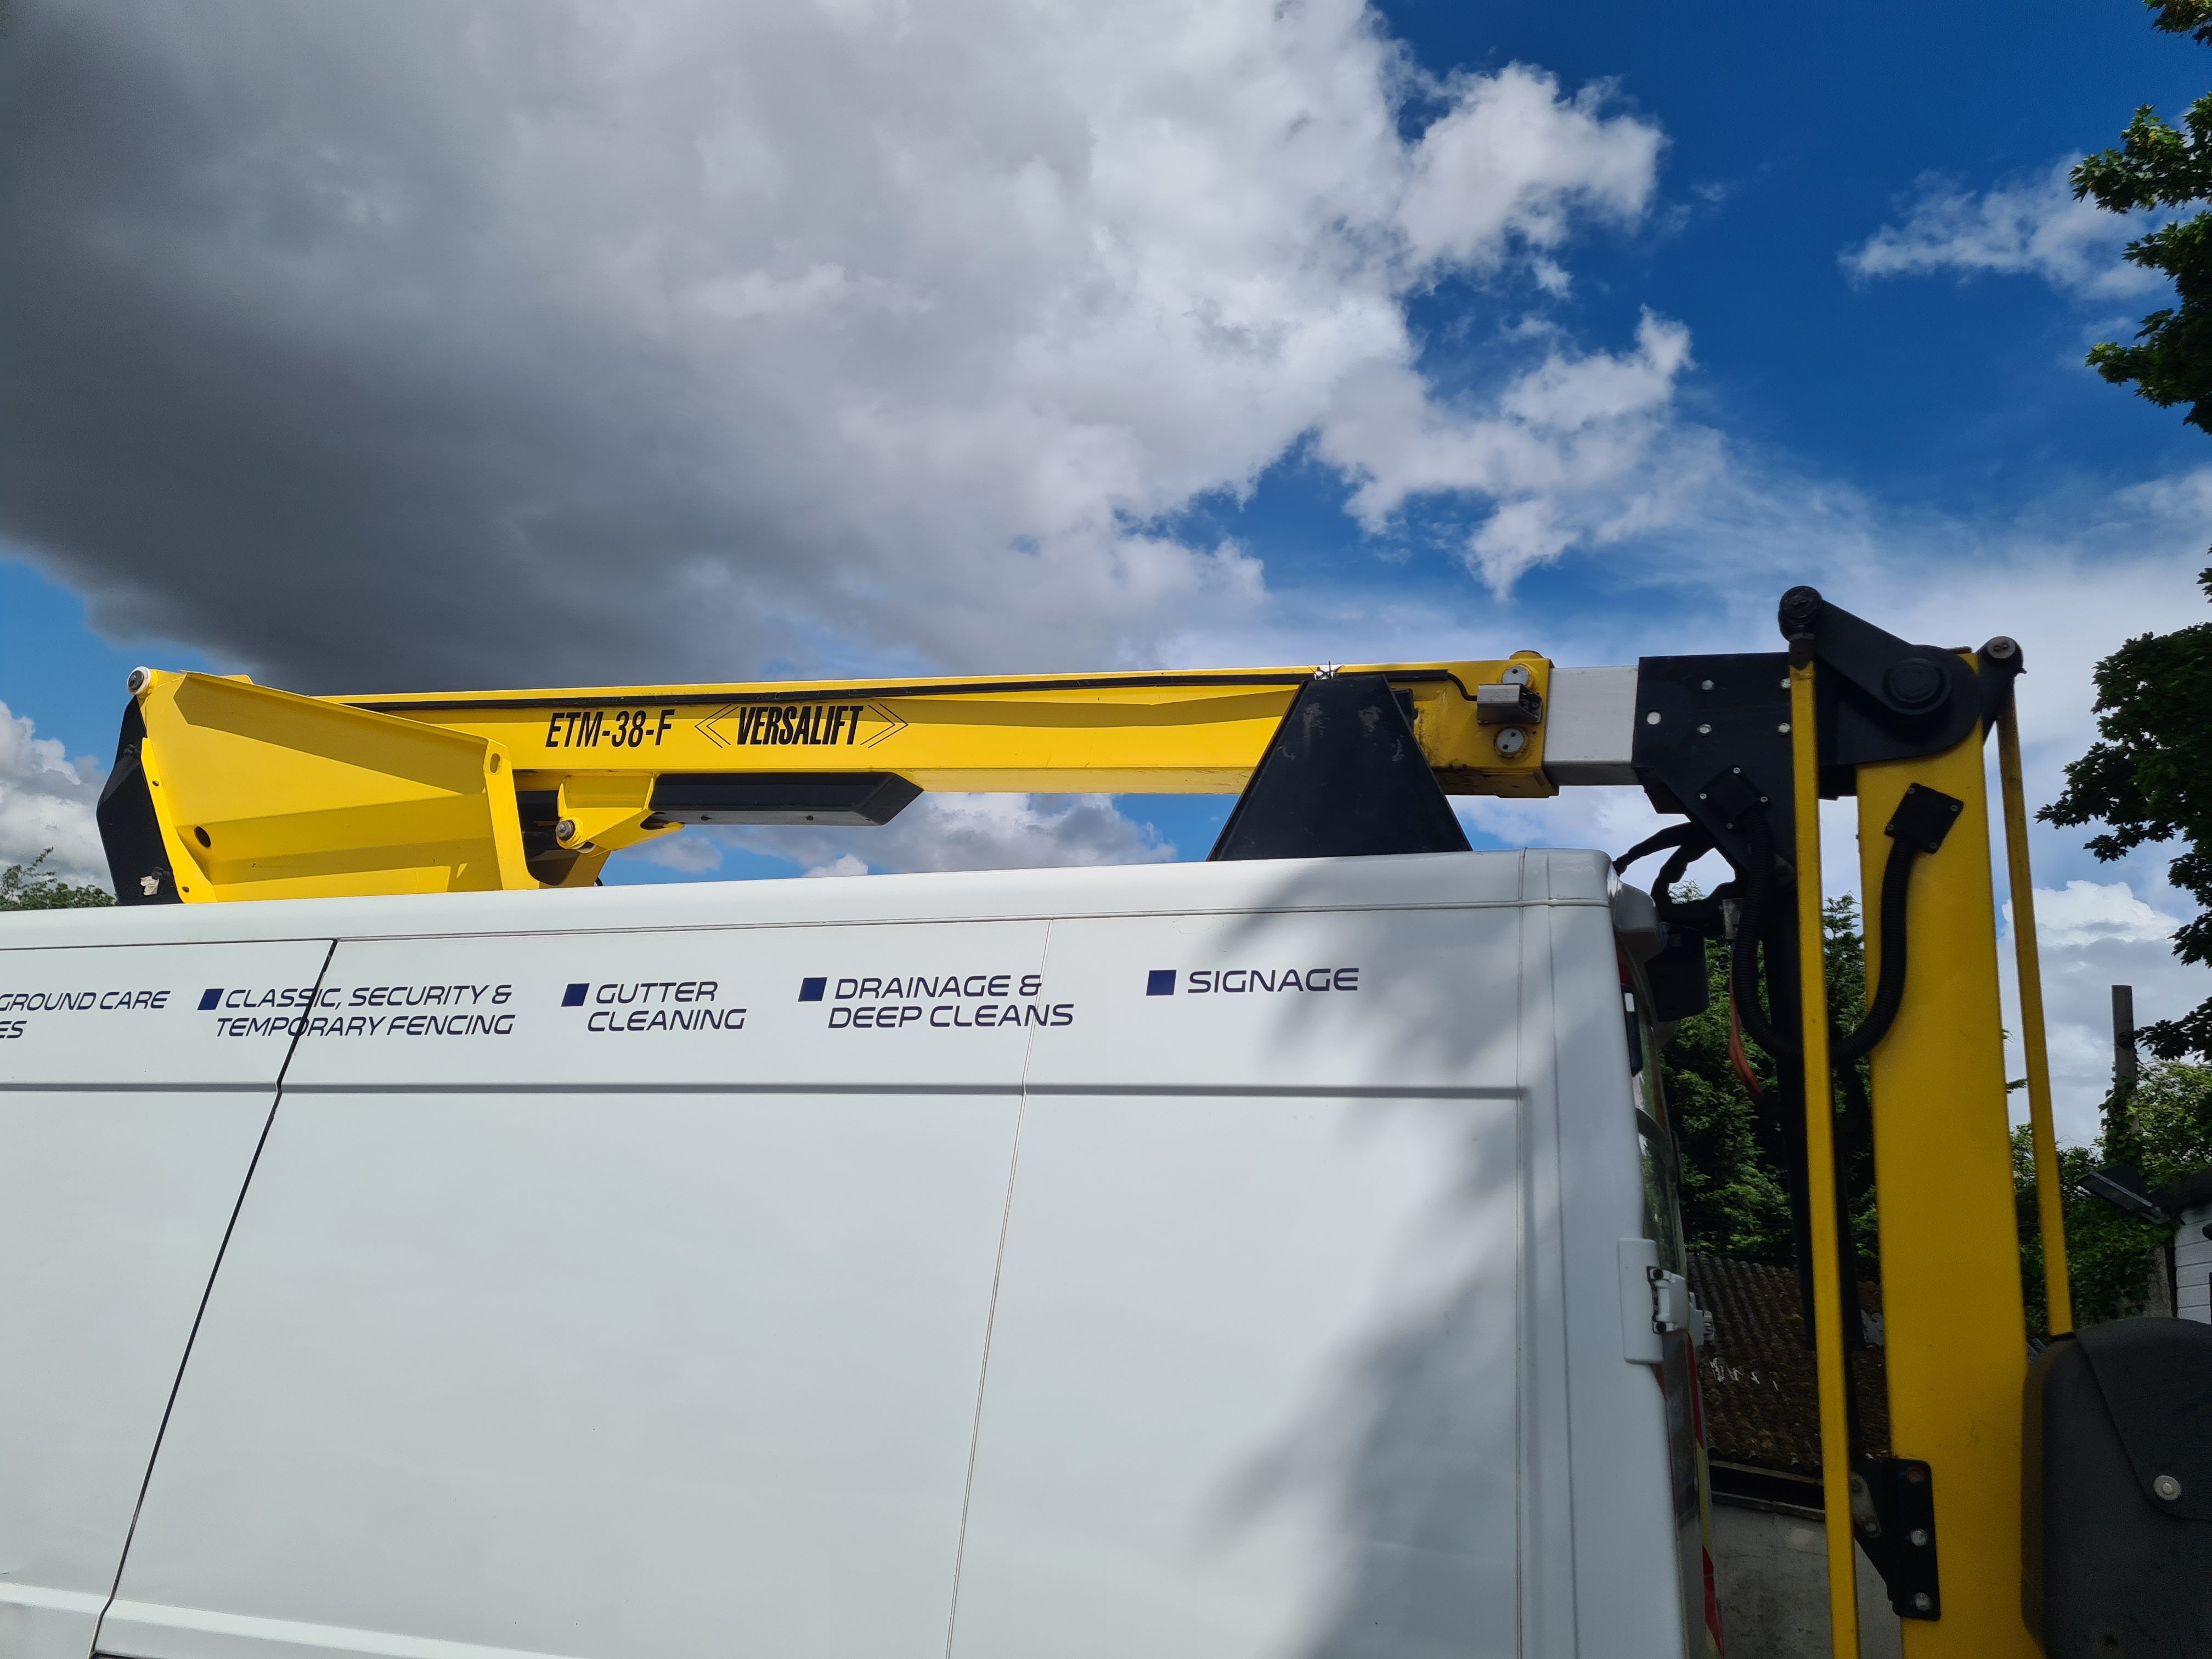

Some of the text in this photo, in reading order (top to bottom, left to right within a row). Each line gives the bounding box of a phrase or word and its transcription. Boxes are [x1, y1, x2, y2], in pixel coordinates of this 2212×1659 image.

[546, 709, 675, 747] ETM-38-F
[737, 706, 864, 745] VERSALIFT
[596, 981, 718, 1003] GUTTER
[835, 975, 1042, 999] DRAINAGE &
[1188, 968, 1359, 993] SIGNAGE
[0, 991, 171, 1011] GROUND CARE
[226, 985, 512, 1009] CLASSIC, SECURITY &
[217, 1015, 516, 1036] TEMPORARY FENCING
[588, 1009, 747, 1031] CLEANING
[828, 1004, 1074, 1028] DEEP CLEANS
